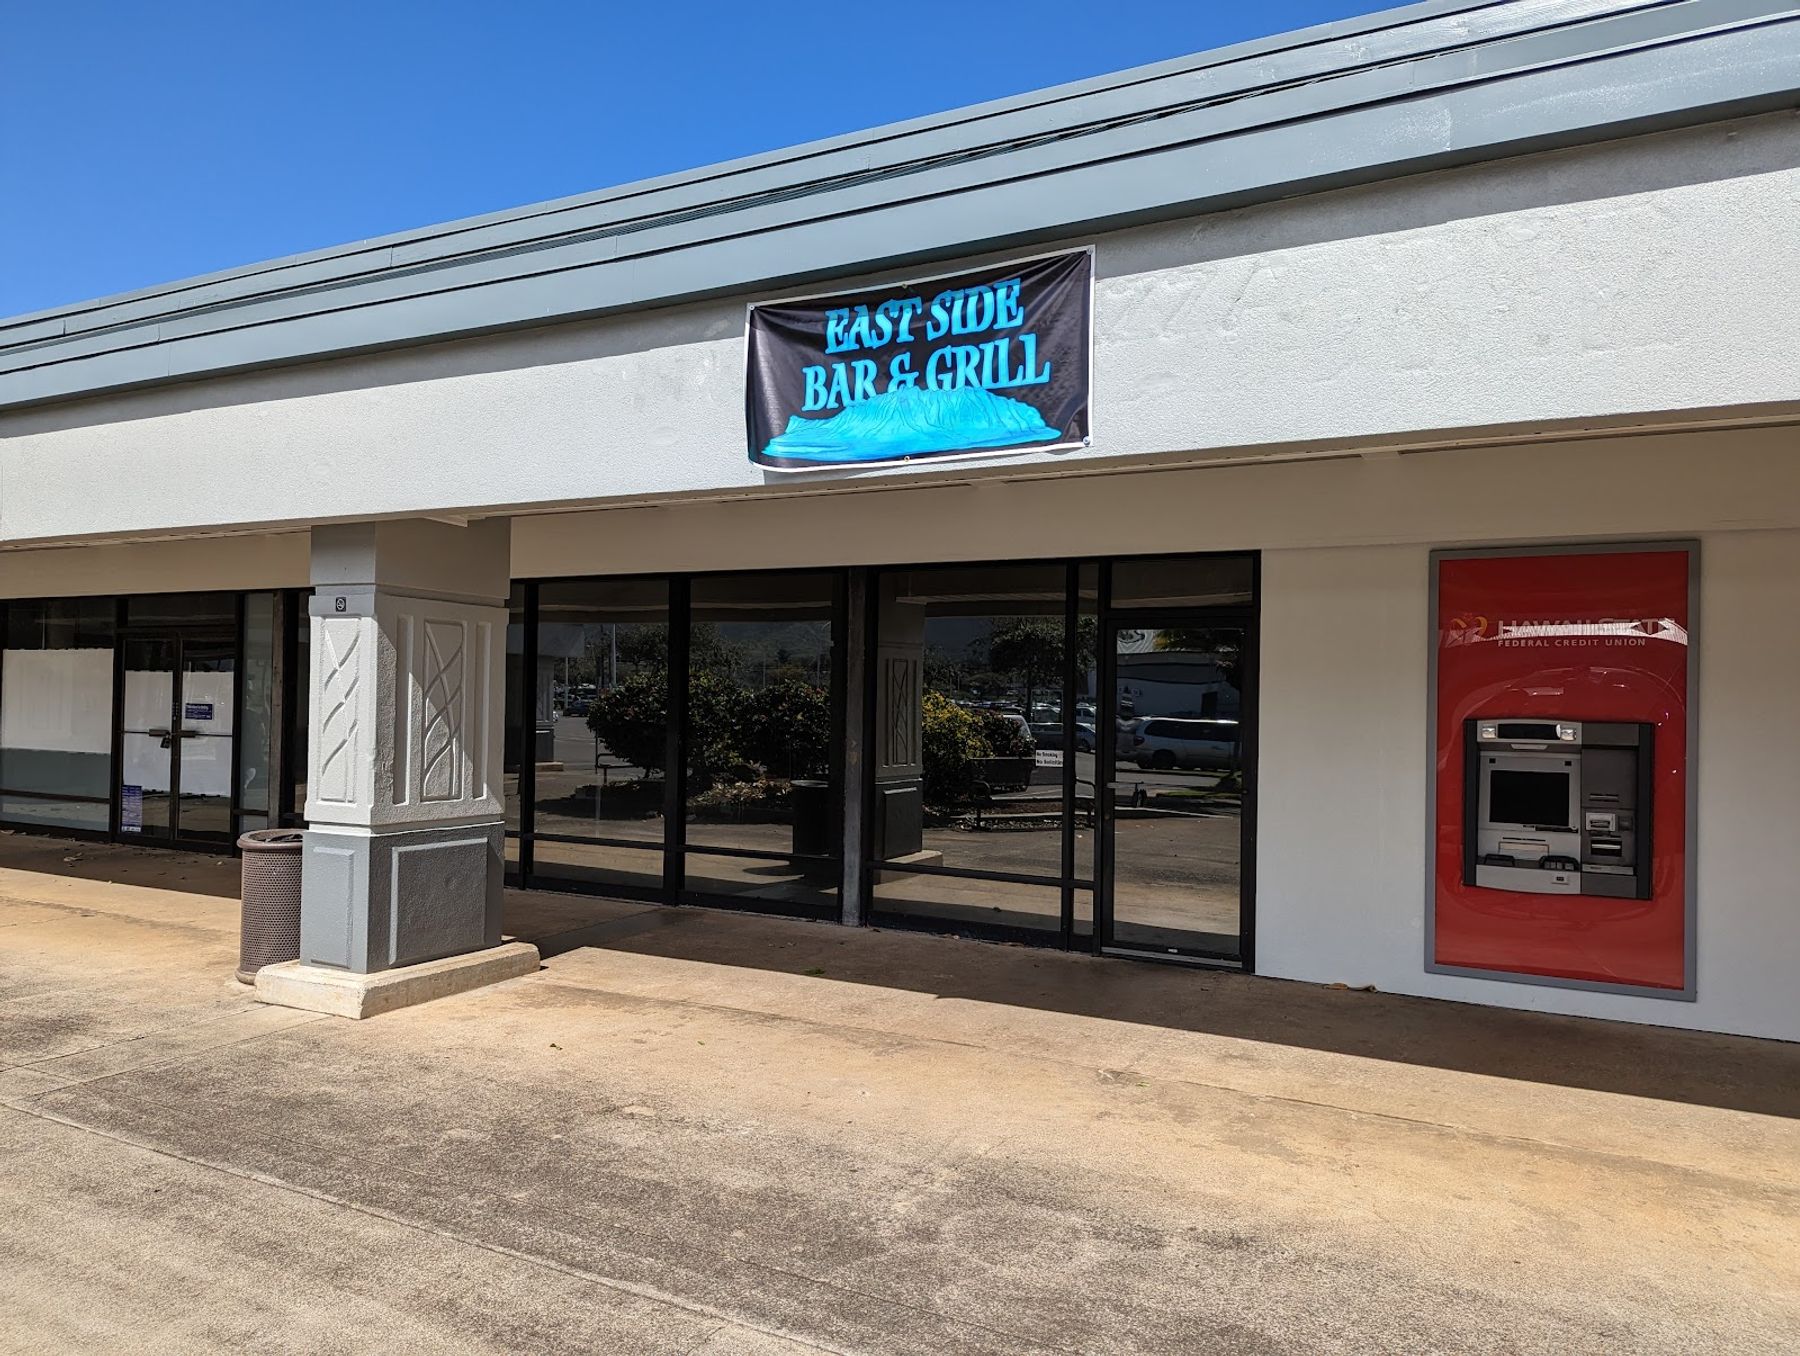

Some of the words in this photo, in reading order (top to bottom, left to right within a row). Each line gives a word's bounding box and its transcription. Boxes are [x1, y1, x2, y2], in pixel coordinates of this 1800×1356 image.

[825, 296, 922, 354] EAST
[926, 277, 1025, 341] SIDE
[802, 359, 877, 411] BAR
[888, 352, 919, 393] &
[926, 332, 1052, 392] GRILL
[1497, 639, 1550, 647] FEDERAL
[1554, 639, 1600, 647] CREDIT
[1605, 638, 1646, 647] UNION
